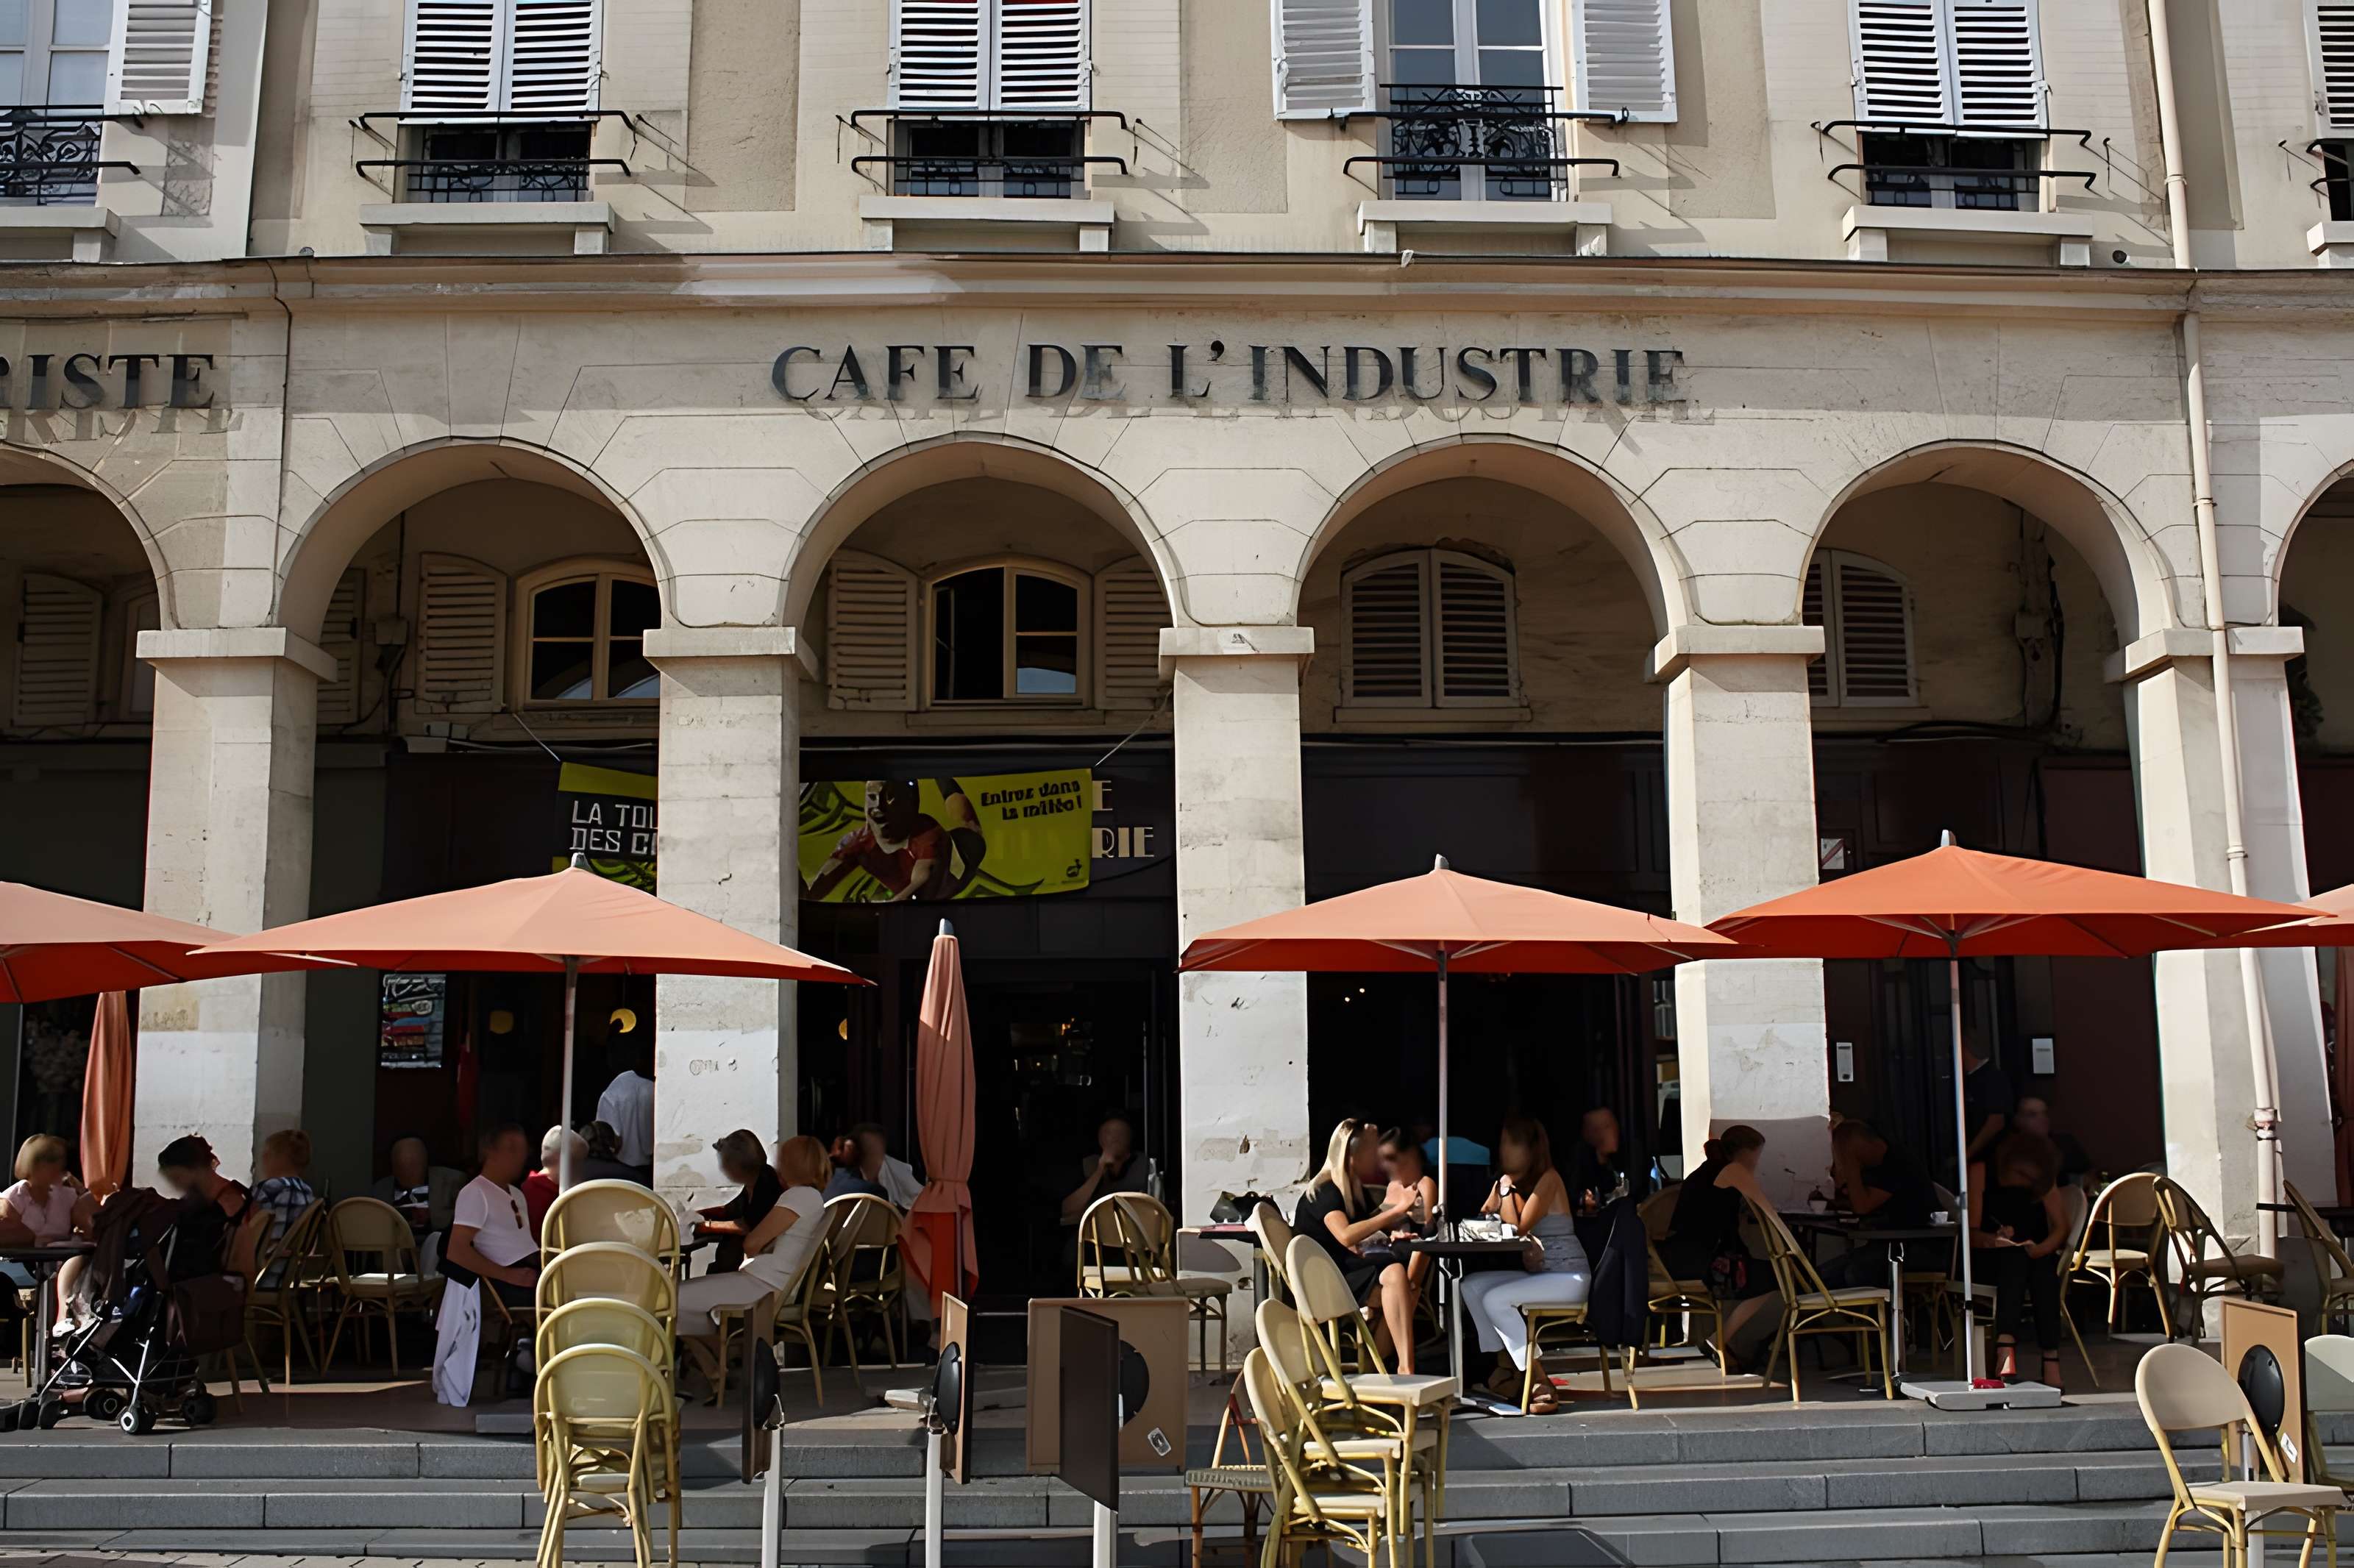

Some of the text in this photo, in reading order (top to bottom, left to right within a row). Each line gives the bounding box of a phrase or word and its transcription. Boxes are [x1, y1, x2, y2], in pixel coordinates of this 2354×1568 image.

[0, 353, 215, 409] ISTE
[771, 343, 981, 401] CAFE
[1025, 343, 1127, 401] DE
[572, 800, 602, 825] LA
[569, 827, 622, 852] DES
